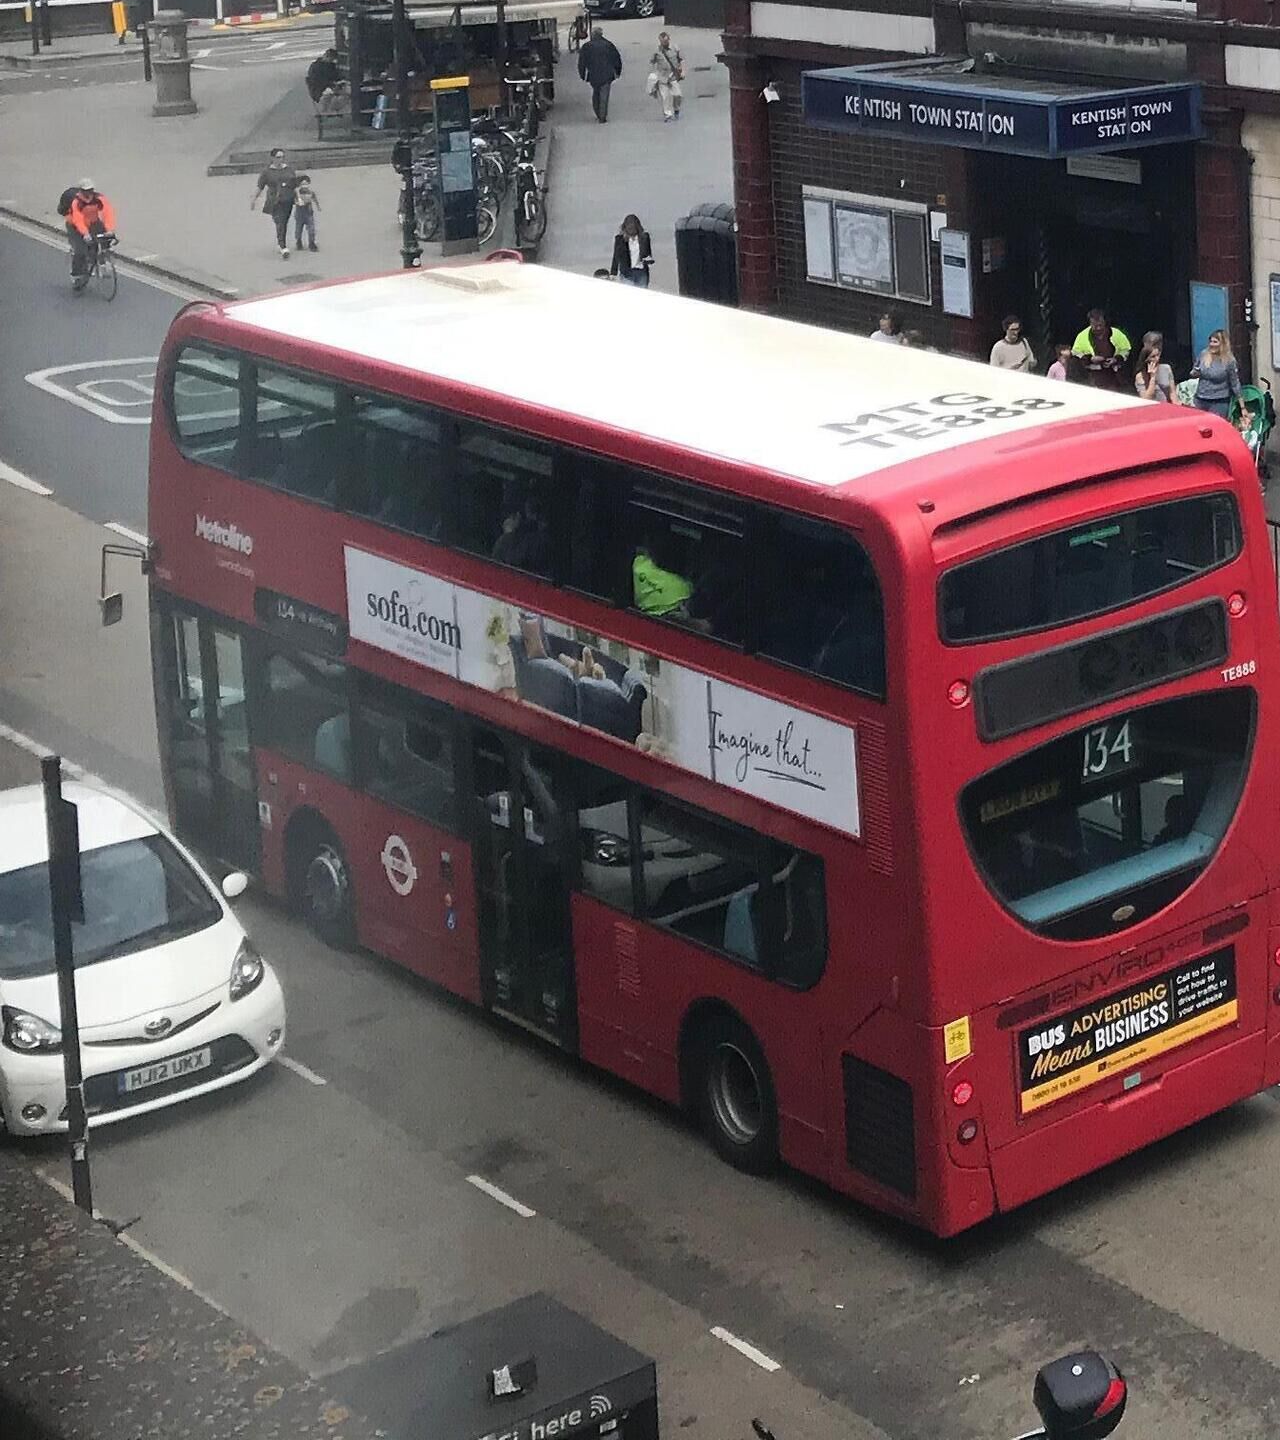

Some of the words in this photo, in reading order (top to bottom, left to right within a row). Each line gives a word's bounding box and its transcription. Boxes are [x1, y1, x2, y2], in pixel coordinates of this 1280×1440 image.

[845, 95, 902, 121] KENTISH
[908, 104, 952, 128] TOWN
[954, 109, 1015, 136] STATION
[1071, 106, 1127, 126] KENTISH
[1132, 100, 1173, 117] TOWN
[1097, 119, 1151, 139] STATON
[818, 392, 993, 436] MTG
[838, 398, 1066, 449] TE888
[366, 589, 462, 651] sofa.com
[1220, 660, 1257, 684] TE888
[708, 710, 773, 783] Imagine
[1082, 718, 1133, 777] 134
[1176, 972, 1191, 985] Call
[1192, 969, 1200, 978] to
[1177, 984, 1190, 996] out
[1190, 978, 1206, 990] how
[1207, 974, 1216, 983] to
[1219, 978, 1228, 987] to
[1028, 1023, 1066, 1057] BUS
[1070, 982, 1169, 1038] ADVERTISING
[1178, 1004, 1195, 1018] your
[1030, 1039, 1094, 1080] Means
[1094, 1000, 1170, 1054] BUSINESS
[130, 1063, 169, 1087] HJ12
[531, 1409, 583, 1440] here
